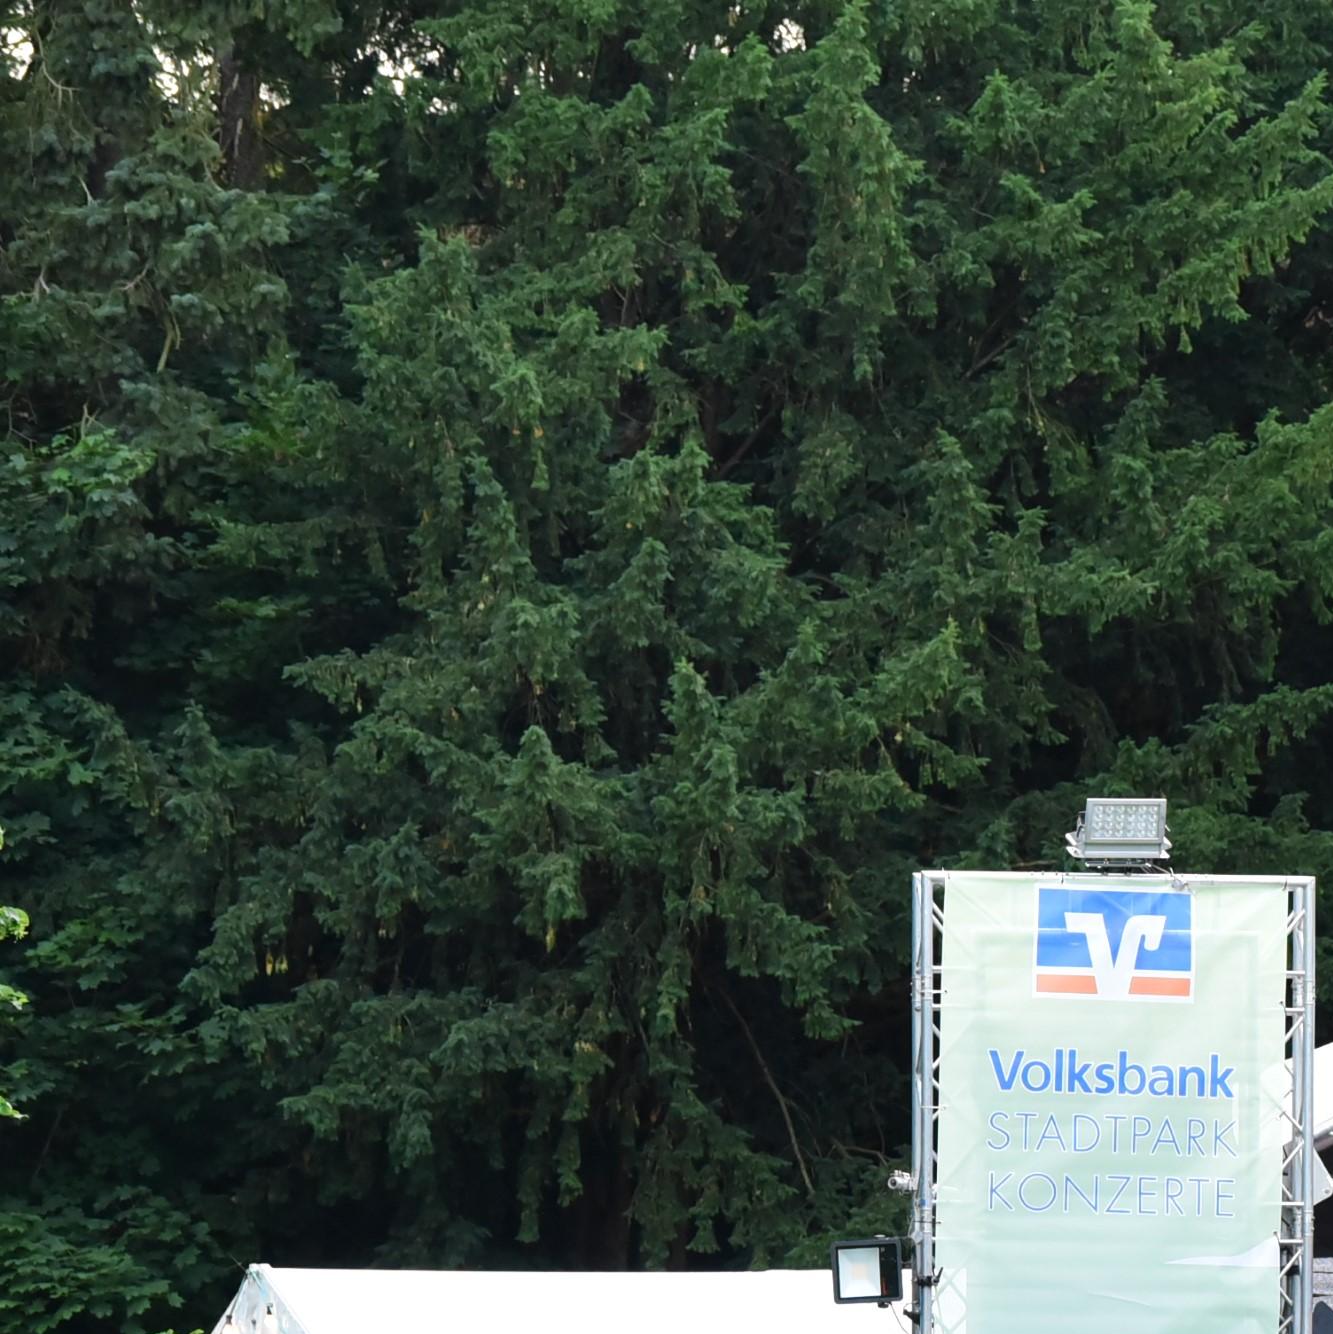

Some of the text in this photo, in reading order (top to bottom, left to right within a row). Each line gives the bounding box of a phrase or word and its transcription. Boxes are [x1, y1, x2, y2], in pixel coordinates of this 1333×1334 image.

[988, 1048, 1235, 1099] Volksbank
[986, 1111, 1238, 1158] STADTPARK
[987, 1171, 1236, 1218] KONZERTE
